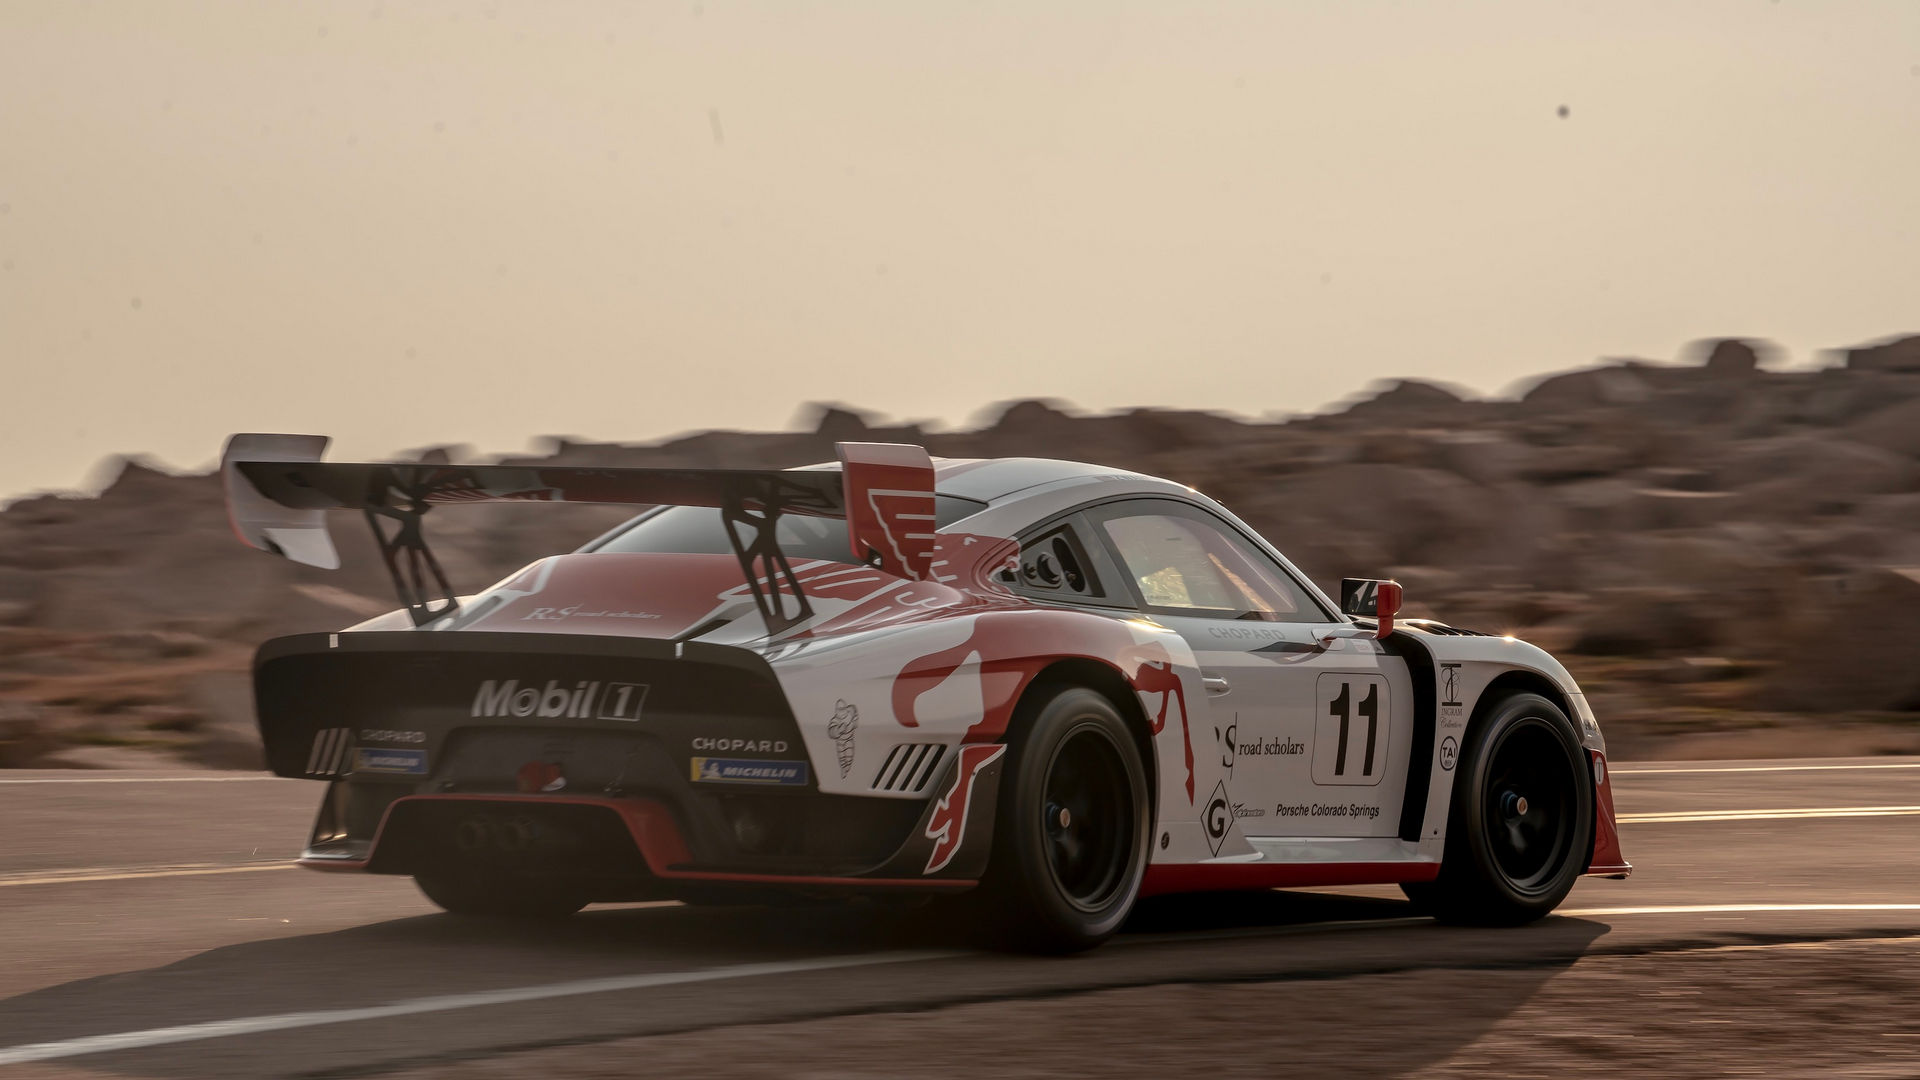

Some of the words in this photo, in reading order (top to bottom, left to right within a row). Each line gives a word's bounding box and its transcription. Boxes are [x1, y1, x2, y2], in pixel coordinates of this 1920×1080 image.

[1207, 627, 1287, 641] CHOPARD
[471, 679, 601, 719] Mobil
[1441, 708, 1463, 717] INGRAM
[1330, 682, 1378, 776] 11
[691, 737, 789, 753] CHOPARD
[1238, 737, 1262, 755] road
[1264, 737, 1305, 755] scholars
[1442, 747, 1456, 759] TAI
[722, 766, 798, 779] MICHELIN
[1207, 798, 1226, 839] G
[1275, 803, 1309, 817] Porsche
[1311, 803, 1348, 817] Colorado
[1349, 803, 1380, 820] Springs
